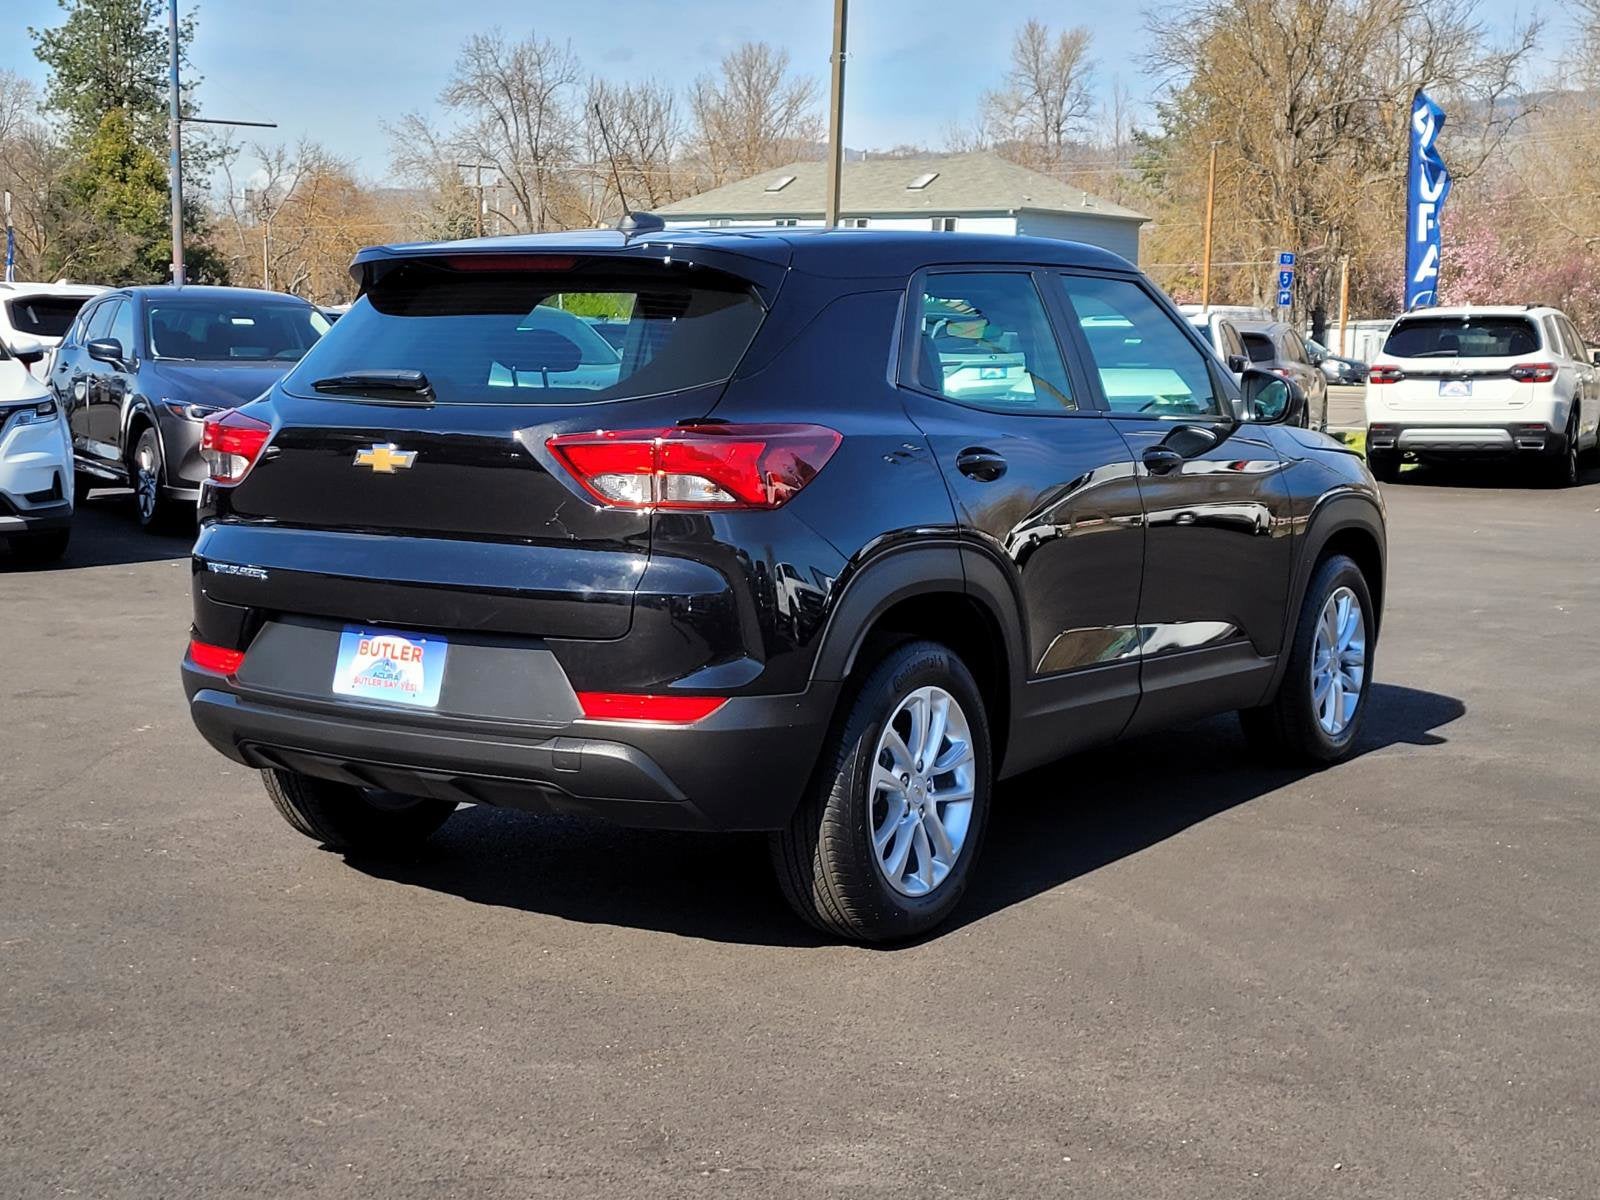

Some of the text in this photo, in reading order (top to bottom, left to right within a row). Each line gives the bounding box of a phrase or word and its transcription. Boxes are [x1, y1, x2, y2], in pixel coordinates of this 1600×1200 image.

[1283, 273, 1289, 284] 5
[359, 640, 423, 663] BUTLER
[353, 675, 382, 687] BUTLER
[383, 679, 399, 689] SAY
[372, 671, 400, 681] ACURA
